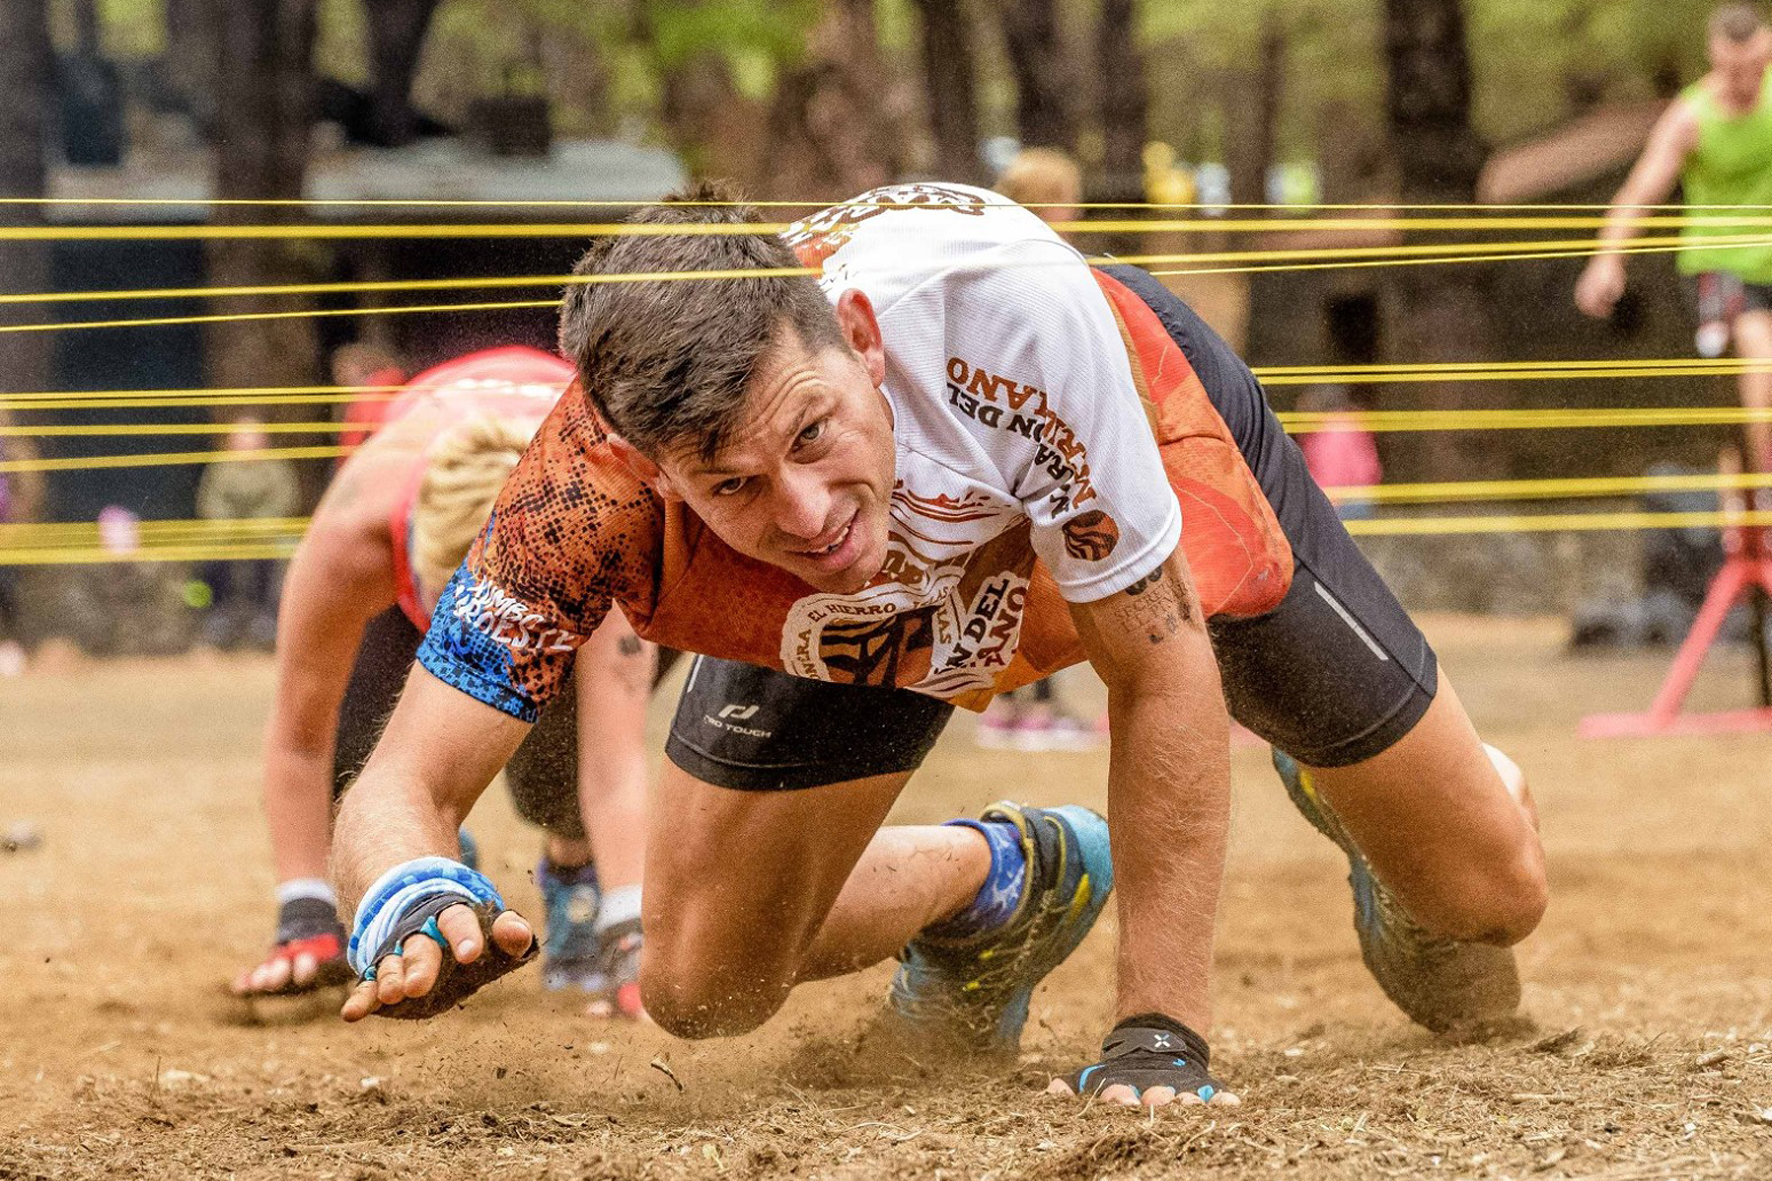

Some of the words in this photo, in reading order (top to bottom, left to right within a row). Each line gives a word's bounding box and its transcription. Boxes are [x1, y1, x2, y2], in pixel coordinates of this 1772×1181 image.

[946, 382, 1004, 429] DEL
[808, 609, 828, 623] EL
[825, 602, 897, 616] HIERRO
[963, 578, 1010, 644] DEL
[725, 723, 772, 738] TOUCH
